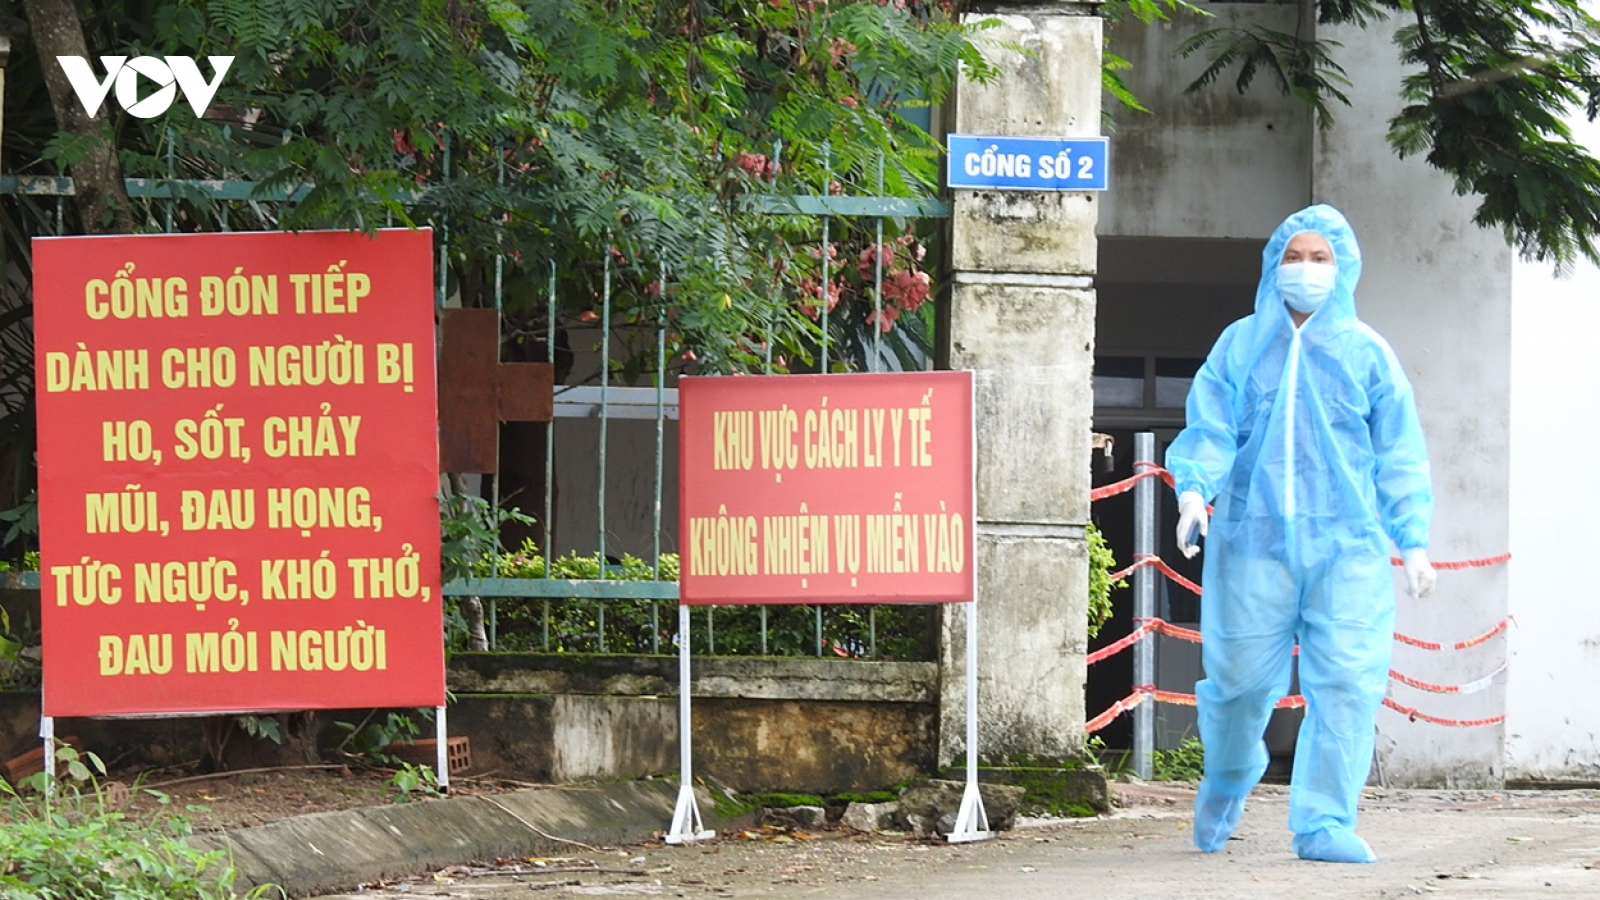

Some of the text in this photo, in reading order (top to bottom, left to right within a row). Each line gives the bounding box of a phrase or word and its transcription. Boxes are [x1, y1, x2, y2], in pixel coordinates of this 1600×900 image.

[965, 144, 1094, 179] CỔNG SỐ 2
[86, 260, 371, 319] CỔNG ĐÓN TIẾP
[46, 335, 414, 392] DÀNH CHO NGƯỜI BỊ
[103, 402, 361, 465] HO, SỐT, CHẢY
[714, 387, 933, 483] KHU VỰC CÁCH LY Y TẾ
[86, 484, 383, 537] MŨI, ĐAU HỌNG,
[690, 492, 964, 589] KHÔNG NHIỆM VỤ MIỄN VÀO
[51, 543, 431, 611] TỨC NGỰC, KHÓ THỞ,
[98, 618, 387, 676] ĐAU MỎI NGƯỜI
